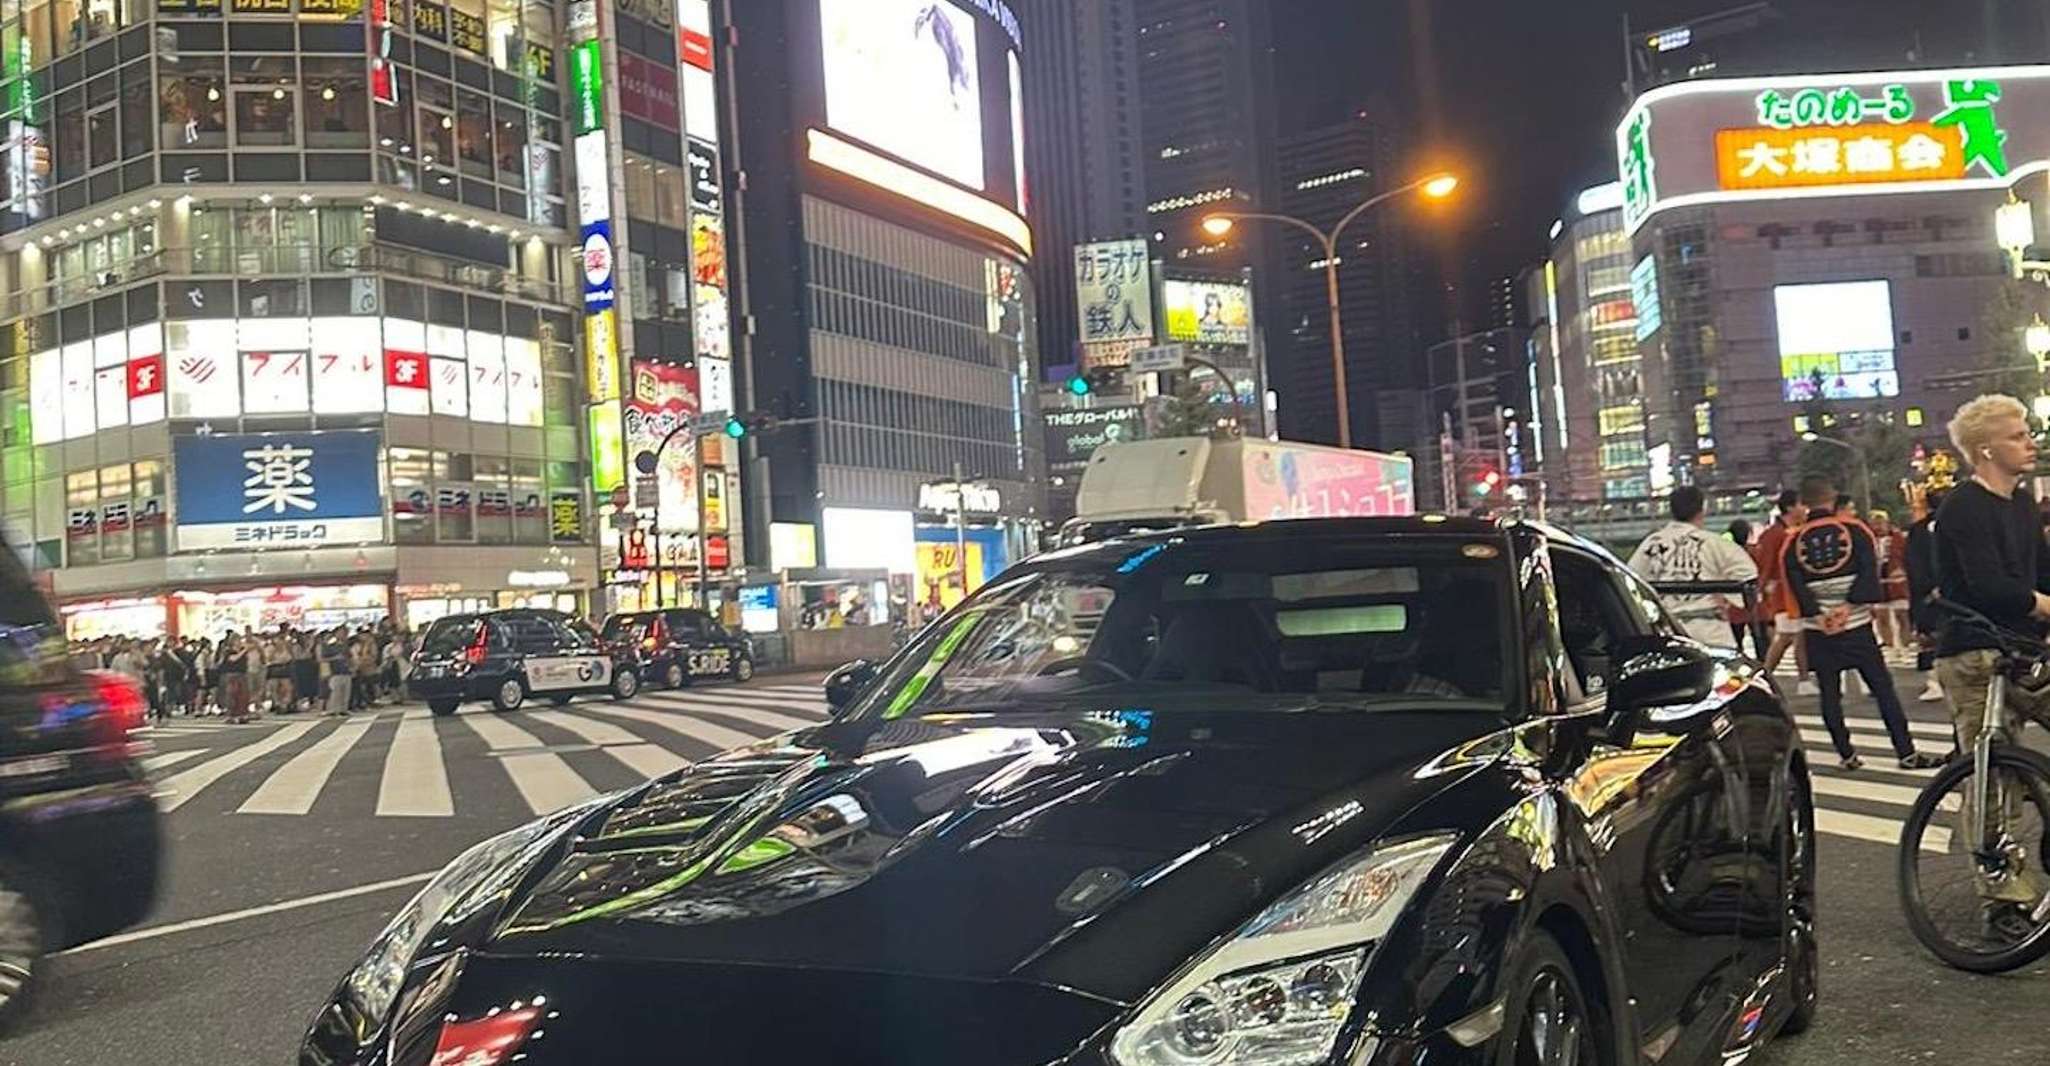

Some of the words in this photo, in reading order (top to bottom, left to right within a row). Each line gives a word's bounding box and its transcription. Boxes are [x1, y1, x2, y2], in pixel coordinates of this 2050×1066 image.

[1759, 87, 1914, 130] たのめーる
[1737, 134, 1946, 178] 大塚商会
[1079, 247, 1144, 282] カラオケ
[1107, 284, 1120, 302] の
[1086, 303, 1142, 336] 鉄人
[241, 444, 317, 514] 薬
[552, 497, 579, 536] 薬
